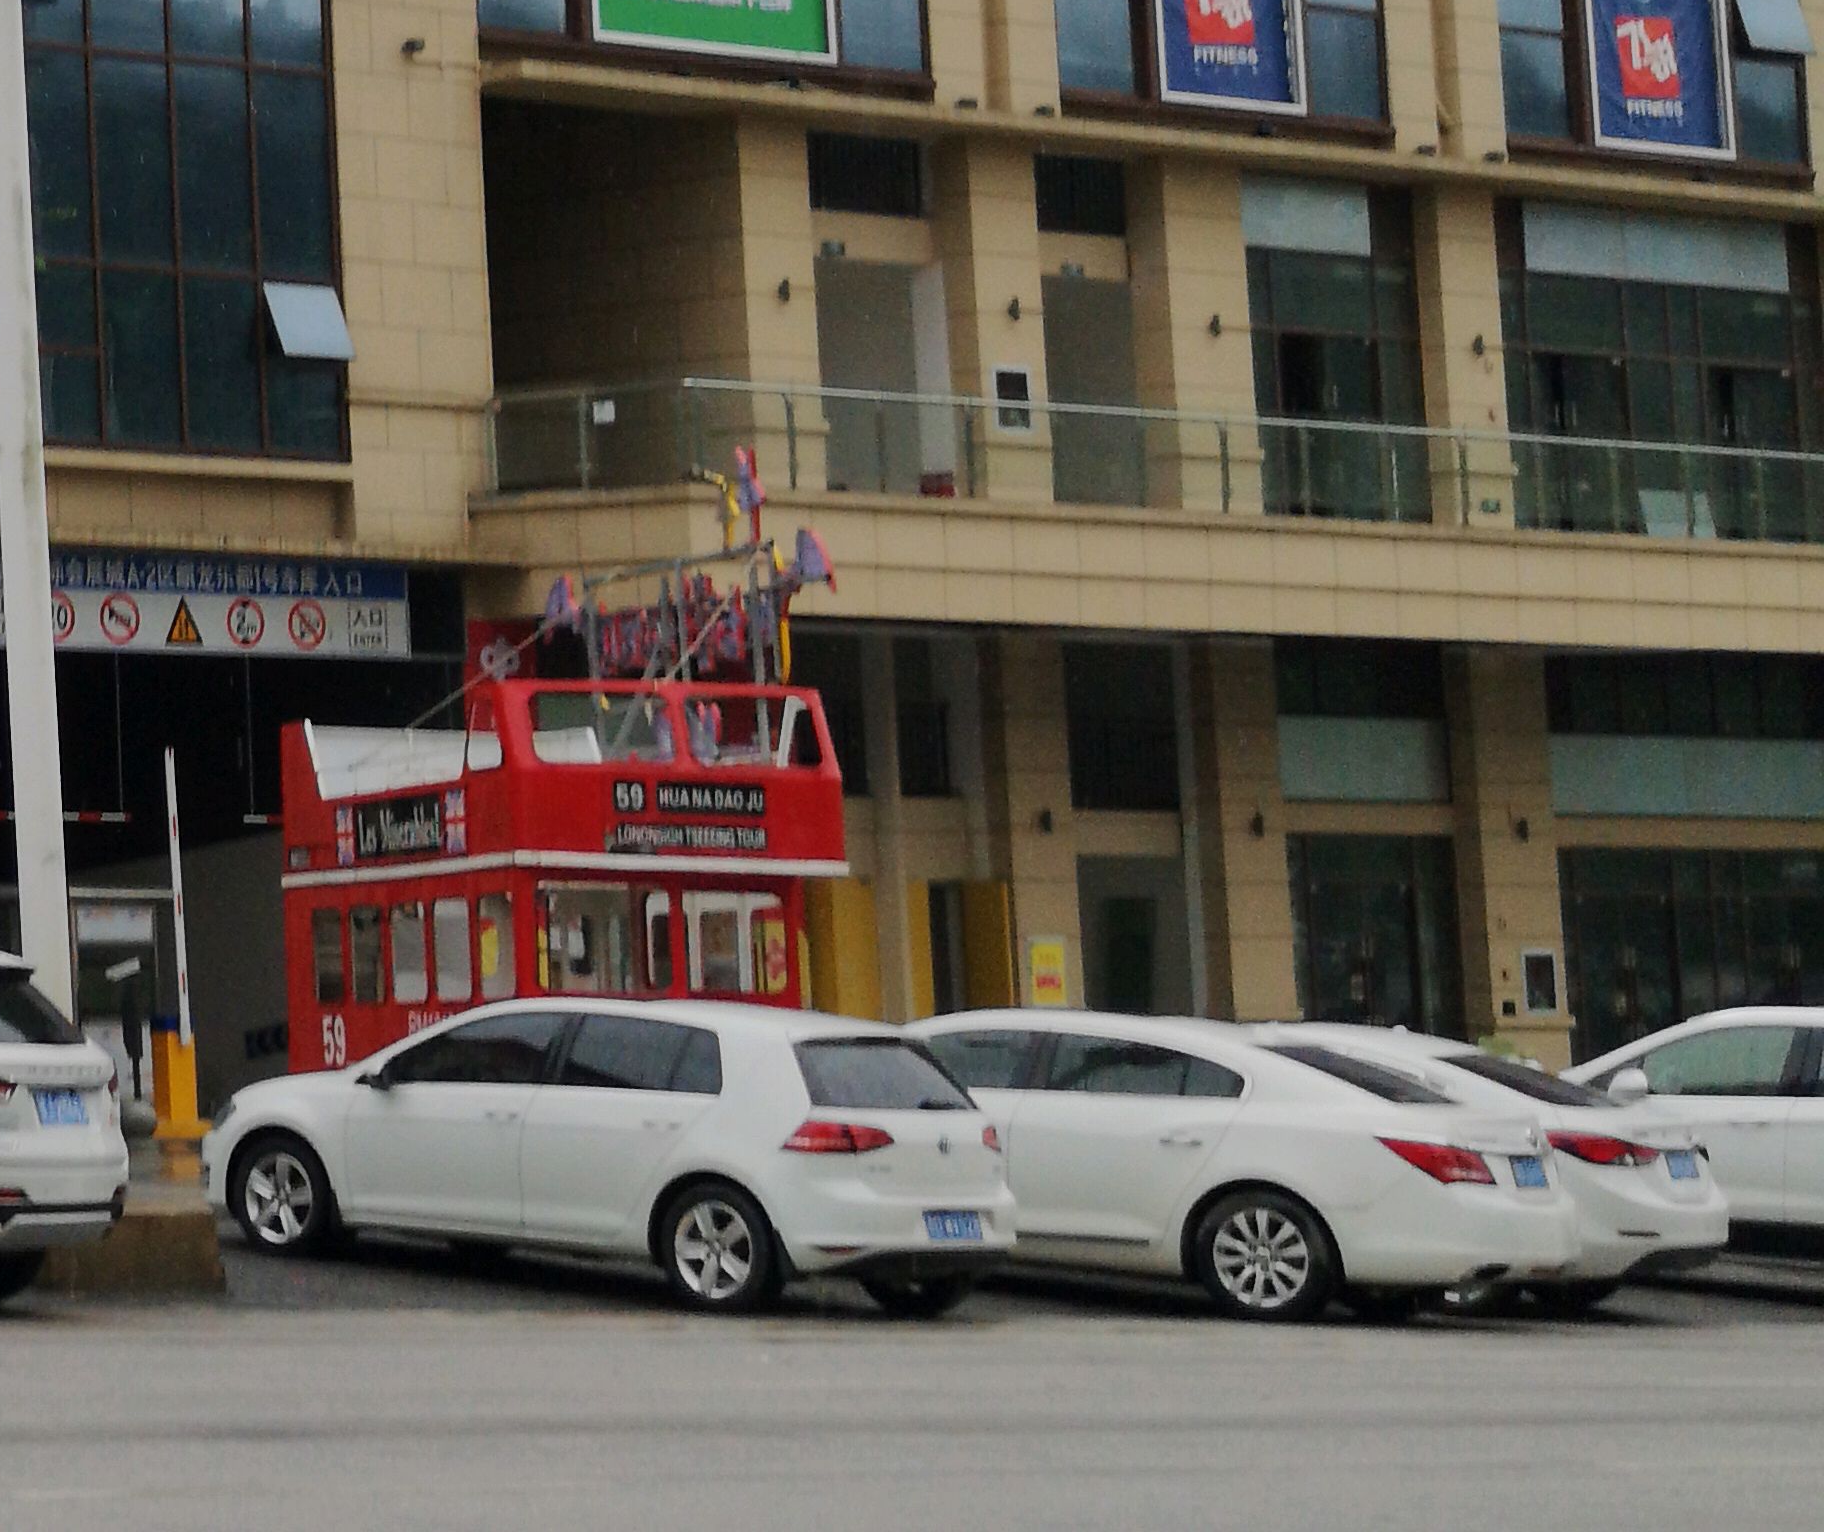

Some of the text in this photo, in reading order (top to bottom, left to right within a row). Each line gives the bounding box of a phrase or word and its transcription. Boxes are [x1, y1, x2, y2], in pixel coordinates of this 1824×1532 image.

[353, 608, 383, 628] 入口
[615, 782, 644, 811] 59
[321, 1013, 347, 1067] 59
